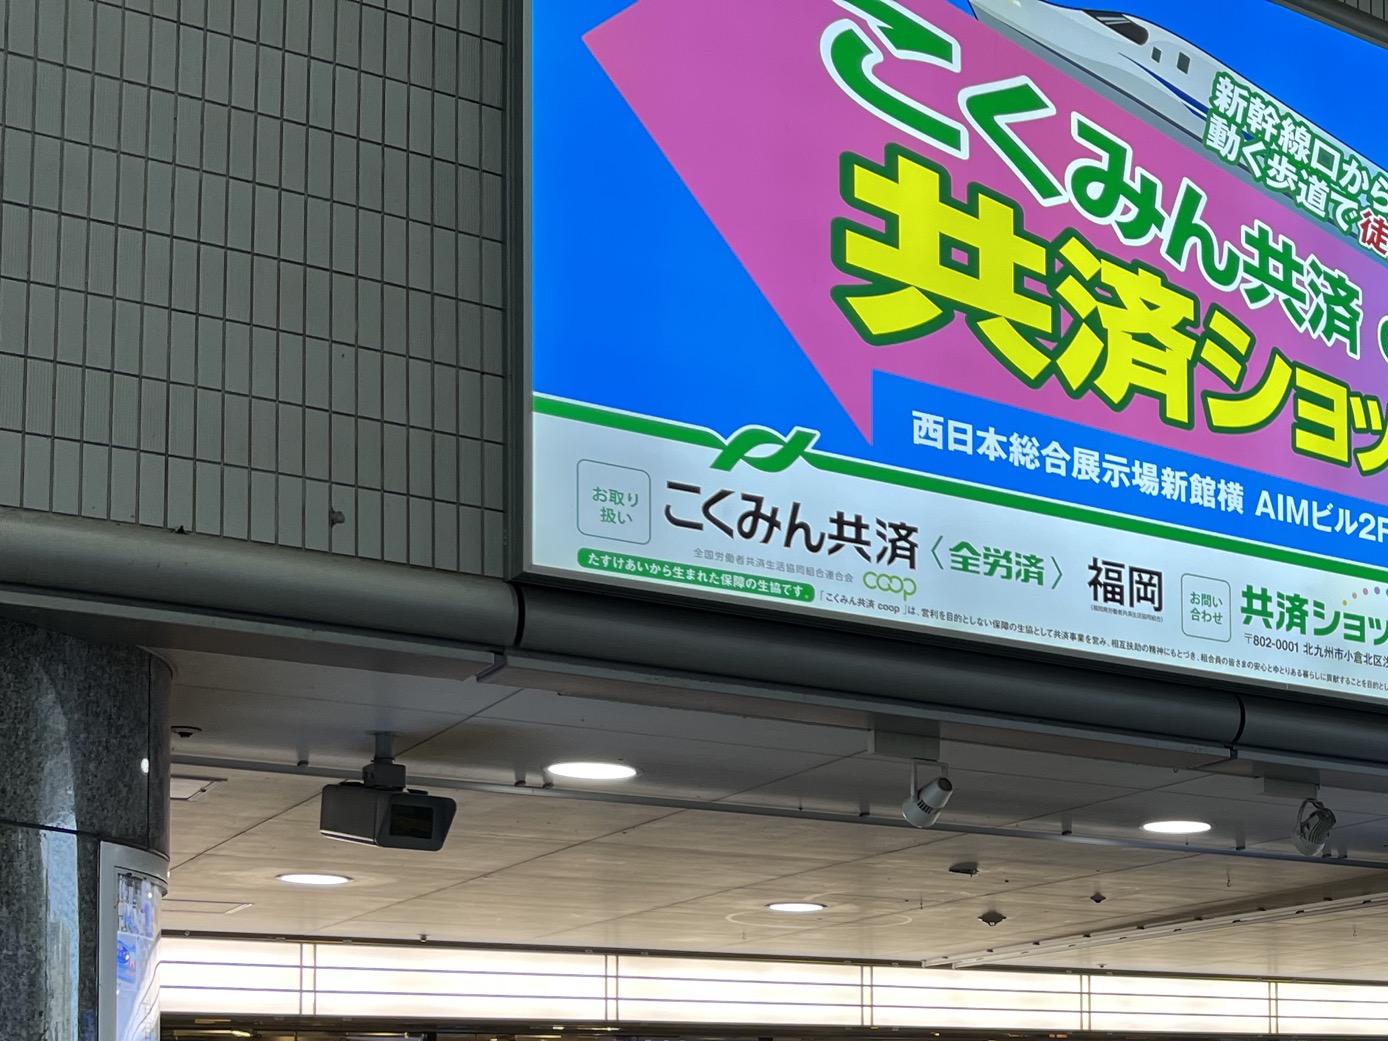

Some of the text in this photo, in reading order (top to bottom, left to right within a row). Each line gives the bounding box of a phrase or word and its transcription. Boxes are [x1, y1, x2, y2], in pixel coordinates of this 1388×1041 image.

[820, 0, 1361, 358] こくみん共済
[912, 410, 1244, 515] 西日本総合展示場新館横
[592, 486, 639, 508] お取り
[600, 507, 633, 525] 扱い
[664, 480, 919, 570] こくみん共済
[1087, 557, 1163, 612] 福岡
[1190, 591, 1223, 608] お問い
[1190, 607, 1223, 625] 合わせ
